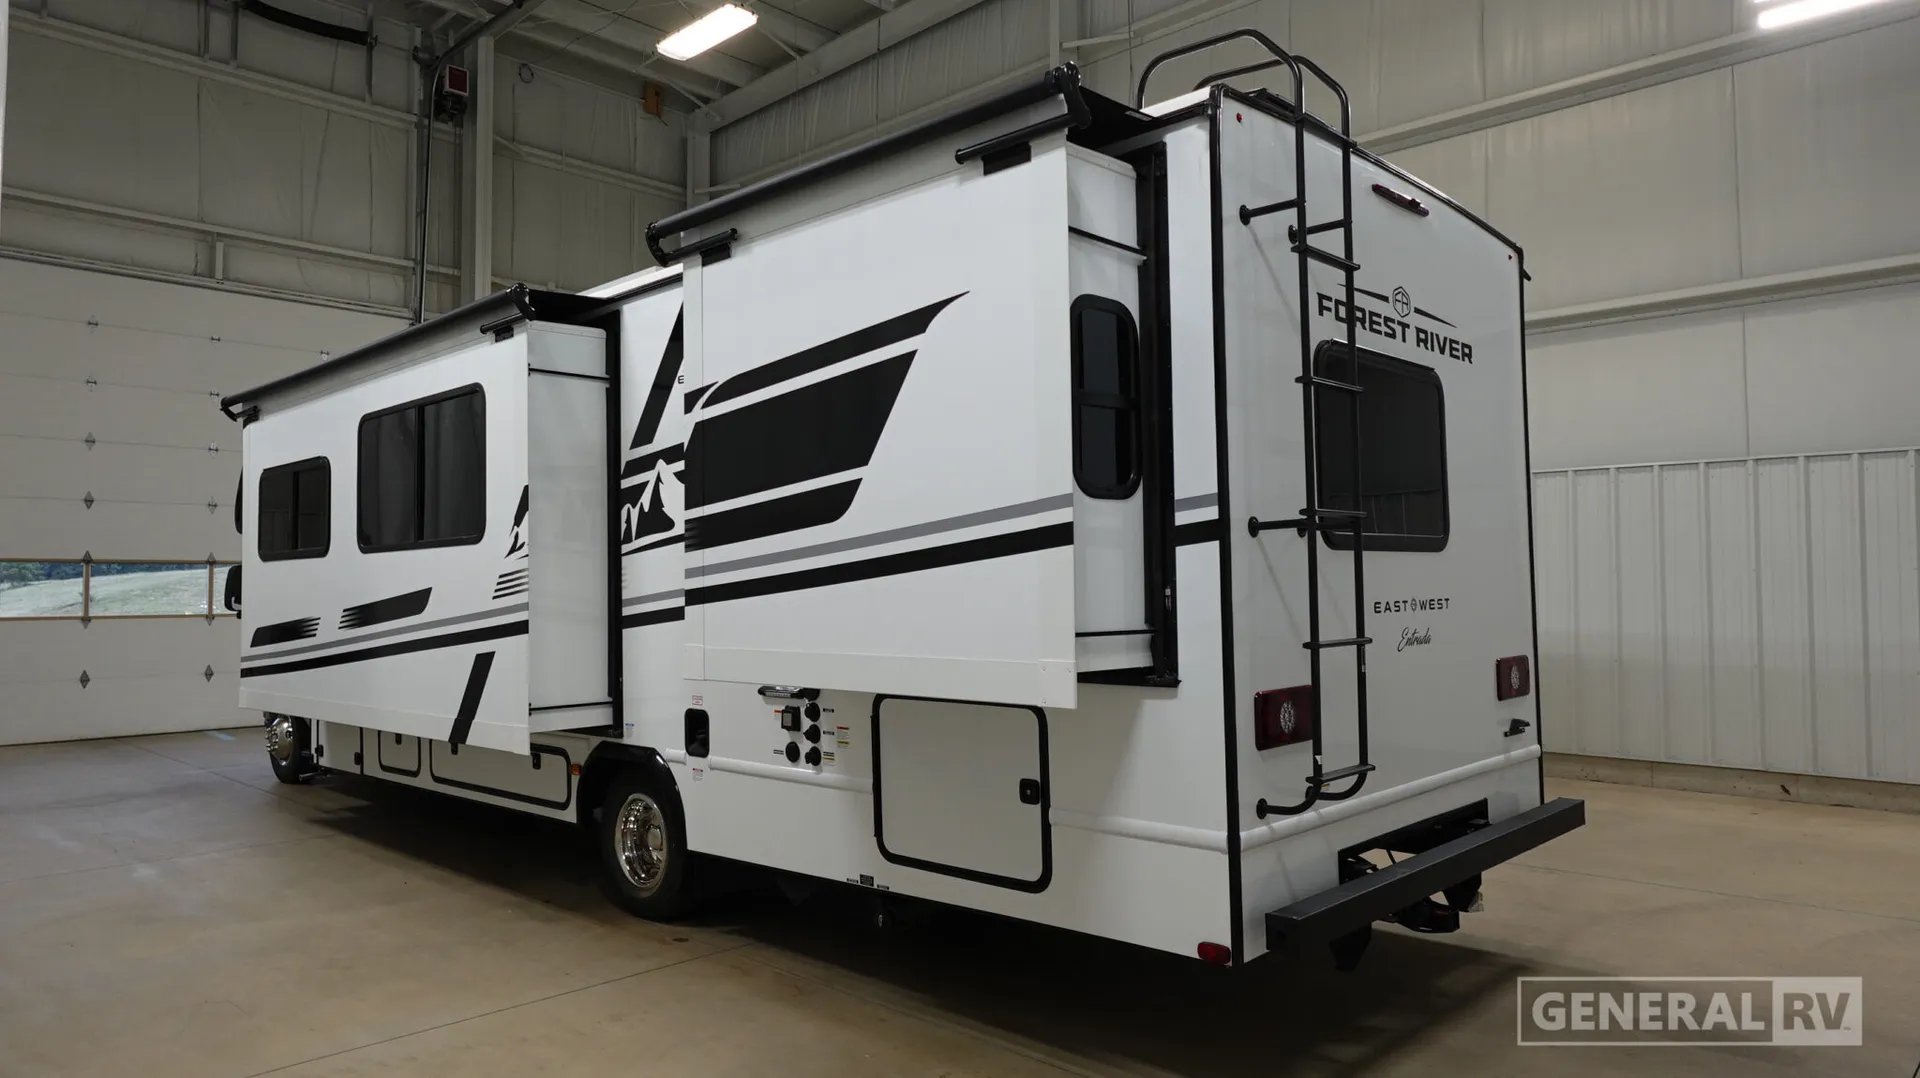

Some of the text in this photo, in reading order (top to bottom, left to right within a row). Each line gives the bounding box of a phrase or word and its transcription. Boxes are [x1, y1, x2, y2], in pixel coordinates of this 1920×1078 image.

[1316, 291, 1473, 364] FOREST RIVER
[1373, 597, 1450, 614] EAST WEST
[1397, 626, 1431, 652] Entrada
